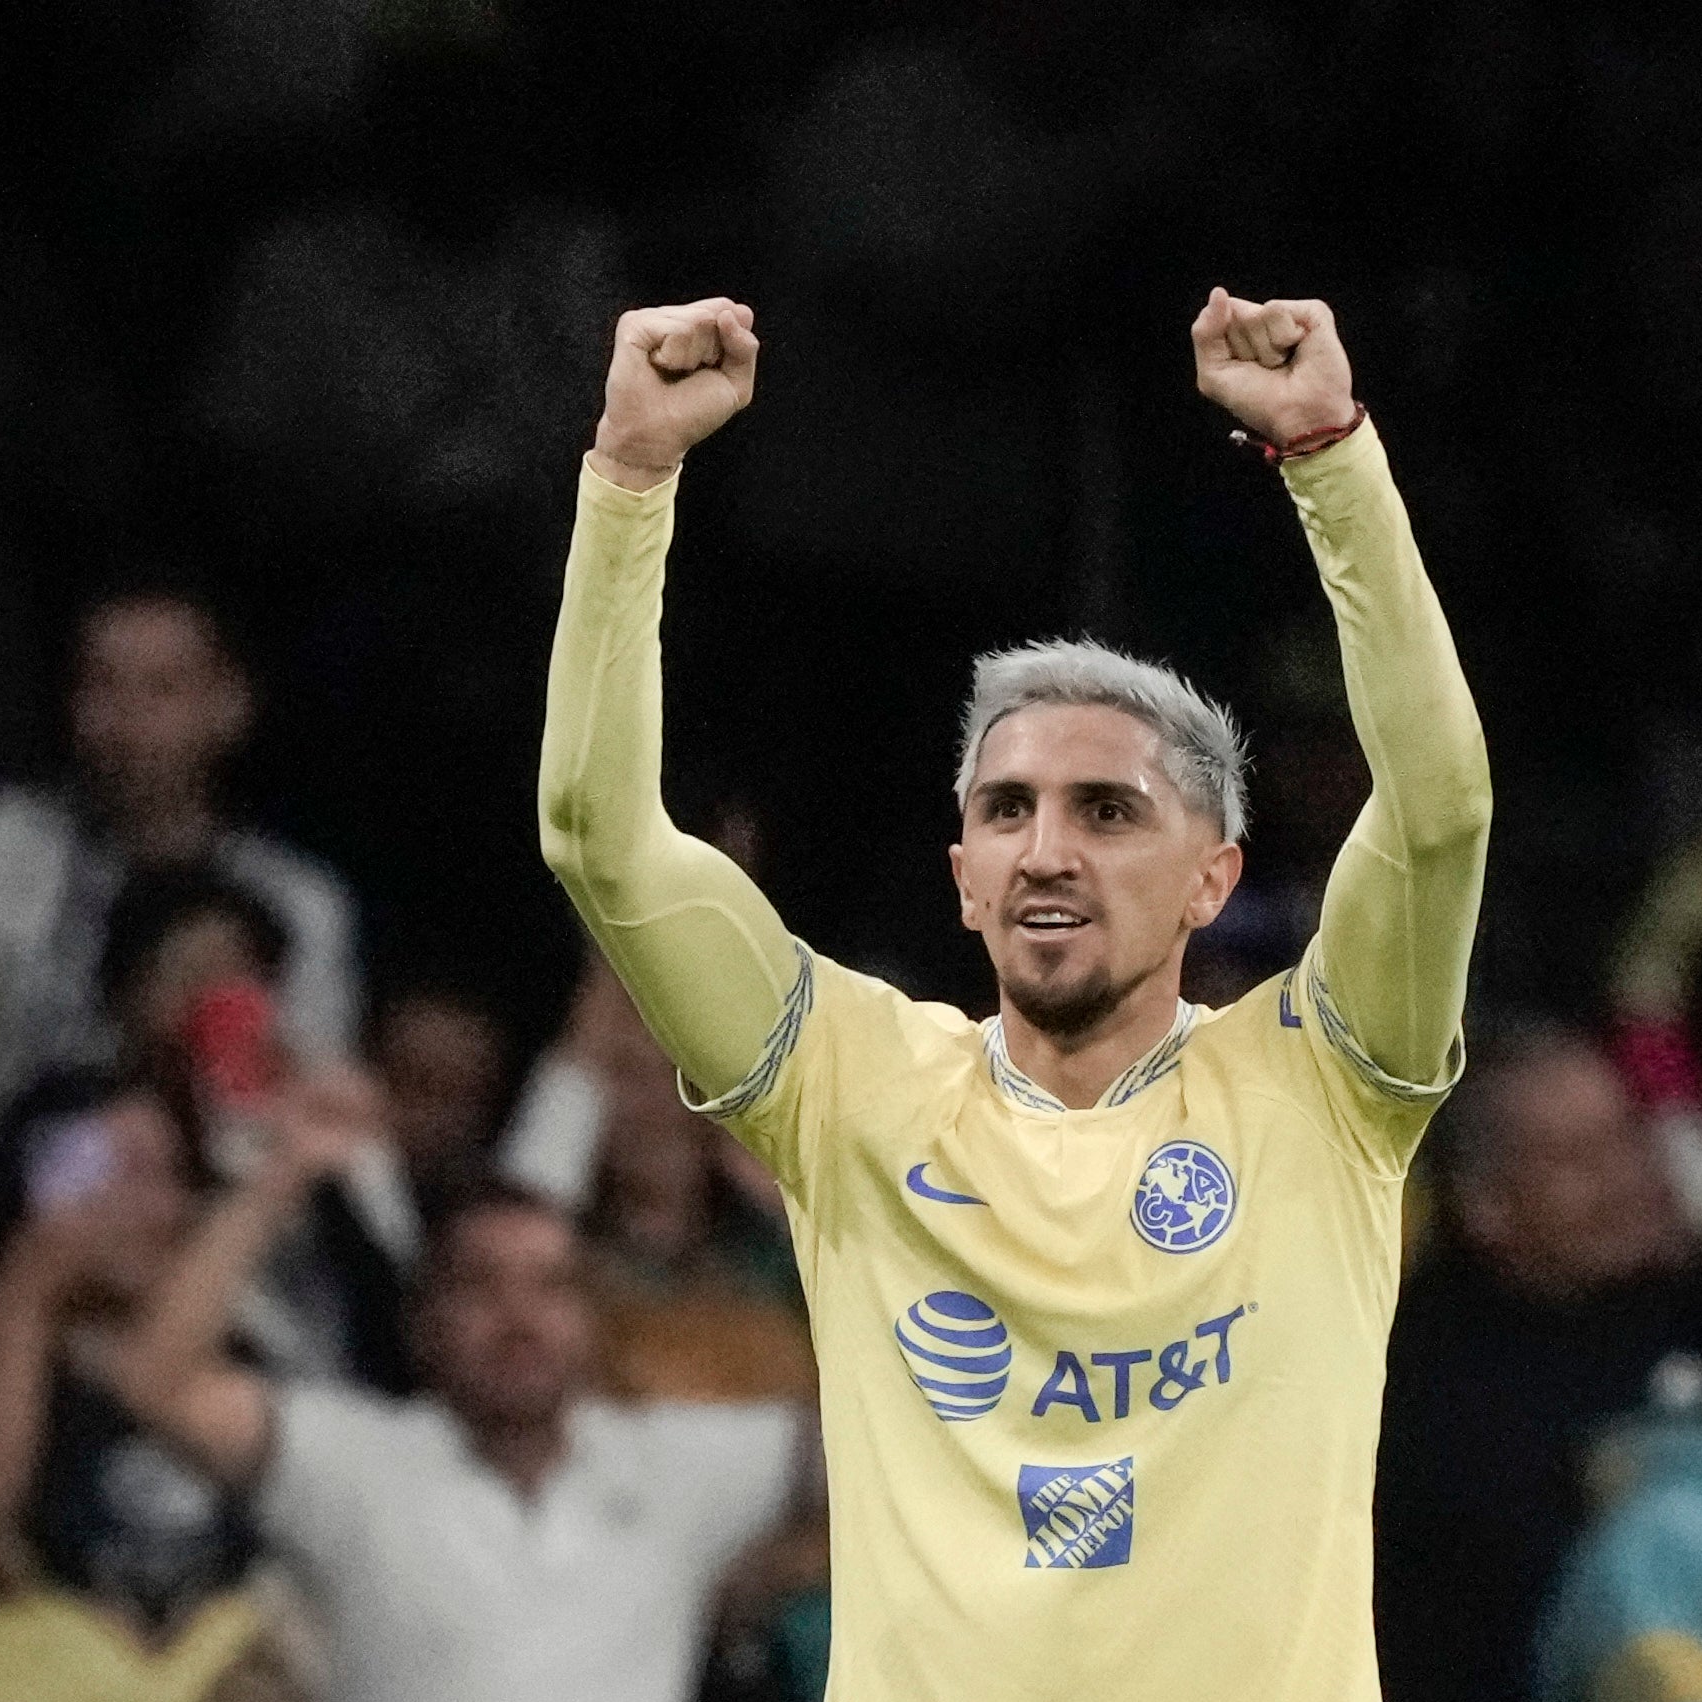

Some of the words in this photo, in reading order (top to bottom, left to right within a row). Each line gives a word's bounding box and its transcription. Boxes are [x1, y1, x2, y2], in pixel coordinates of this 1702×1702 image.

[1031, 1305, 1245, 1423] AT&T
[1028, 1474, 1078, 1513] THE
[1028, 1462, 1133, 1568] HOME
[1064, 1495, 1133, 1568] DEPOT
